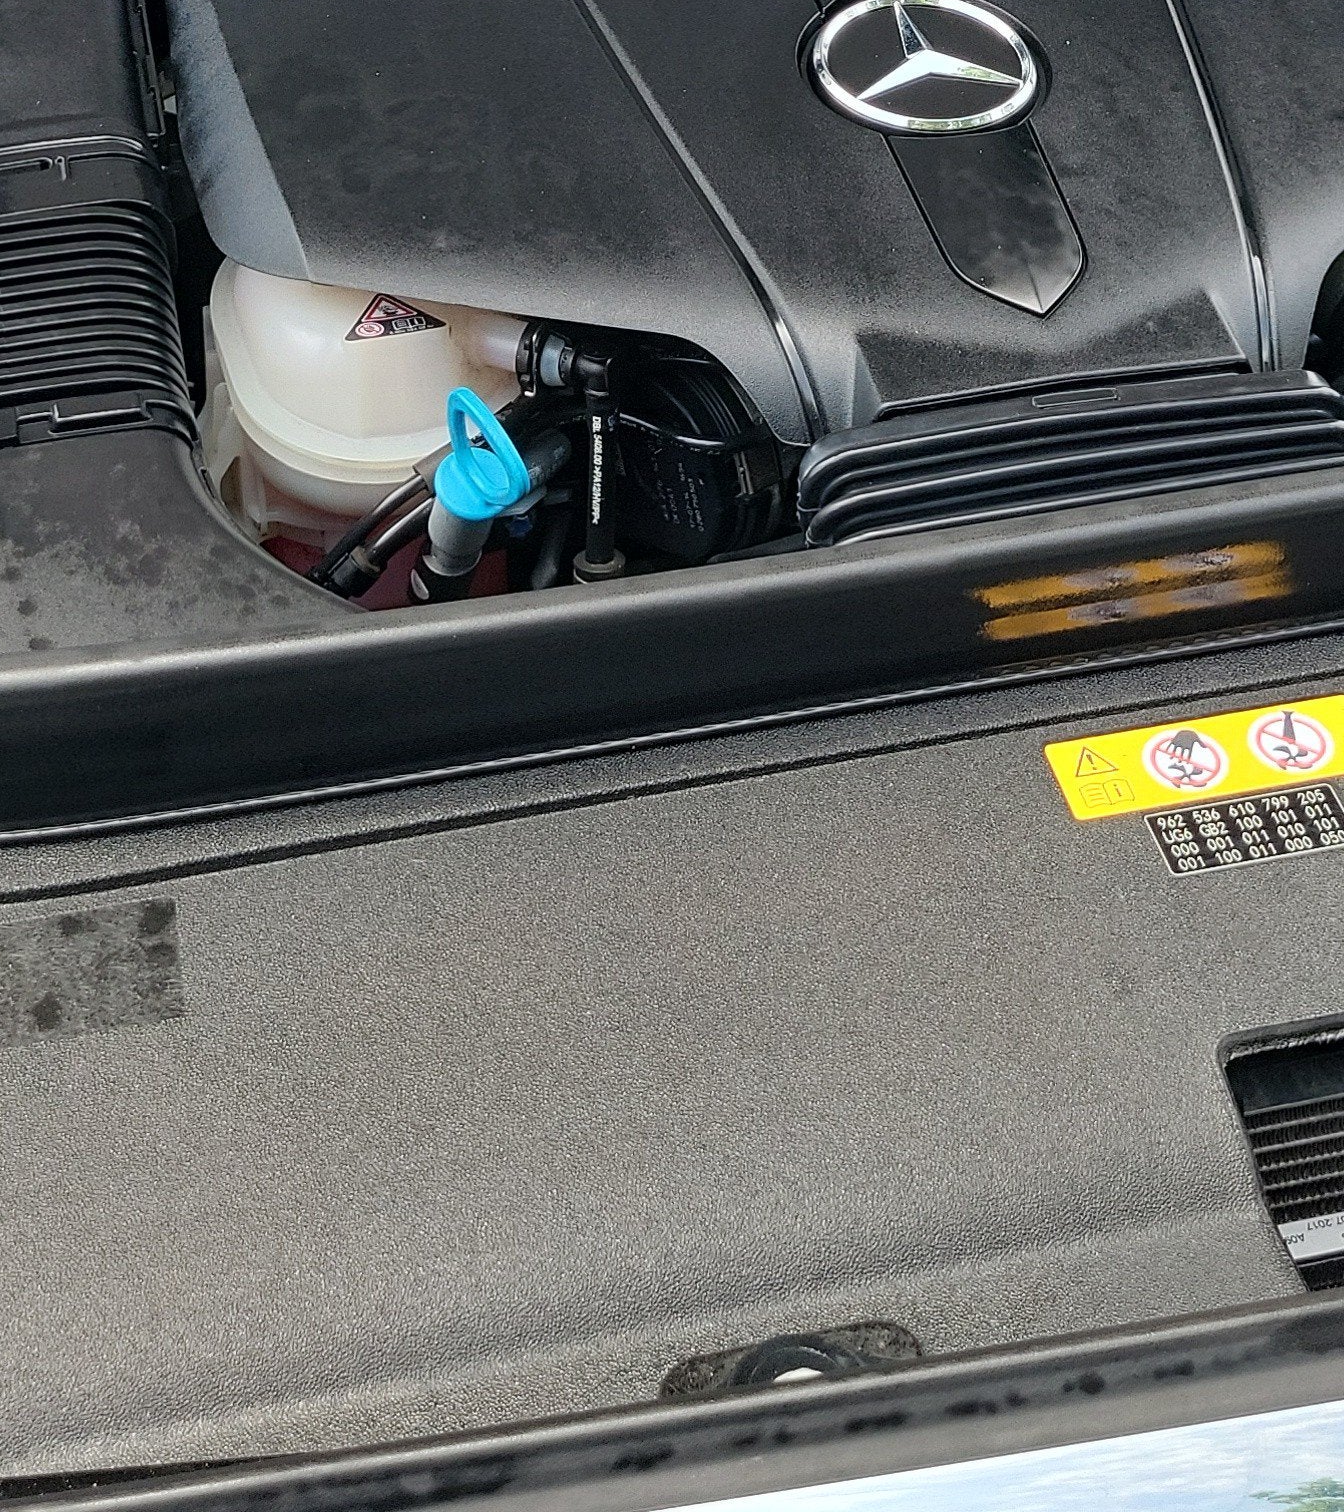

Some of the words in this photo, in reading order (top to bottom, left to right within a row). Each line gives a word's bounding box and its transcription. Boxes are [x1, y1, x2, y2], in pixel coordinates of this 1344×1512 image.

[1157, 814, 1183, 831] 962
[1193, 809, 1221, 824] 536
[1228, 802, 1255, 817] 610
[1261, 796, 1289, 811] 799
[1297, 789, 1325, 805] 205
[1200, 822, 1229, 838] GB2
[1237, 815, 1262, 831] 100
[1271, 809, 1297, 824] 101
[1305, 802, 1332, 818] 011
[1171, 842, 1199, 858] 000
[1207, 836, 1234, 851] 001
[1242, 829, 1269, 844] 011
[1278, 822, 1305, 837] 010
[1313, 816, 1340, 831] 101
[1178, 856, 1206, 872] 001
[1215, 849, 1242, 865] 100
[1249, 842, 1277, 858] 011
[1285, 836, 1313, 851] 000
